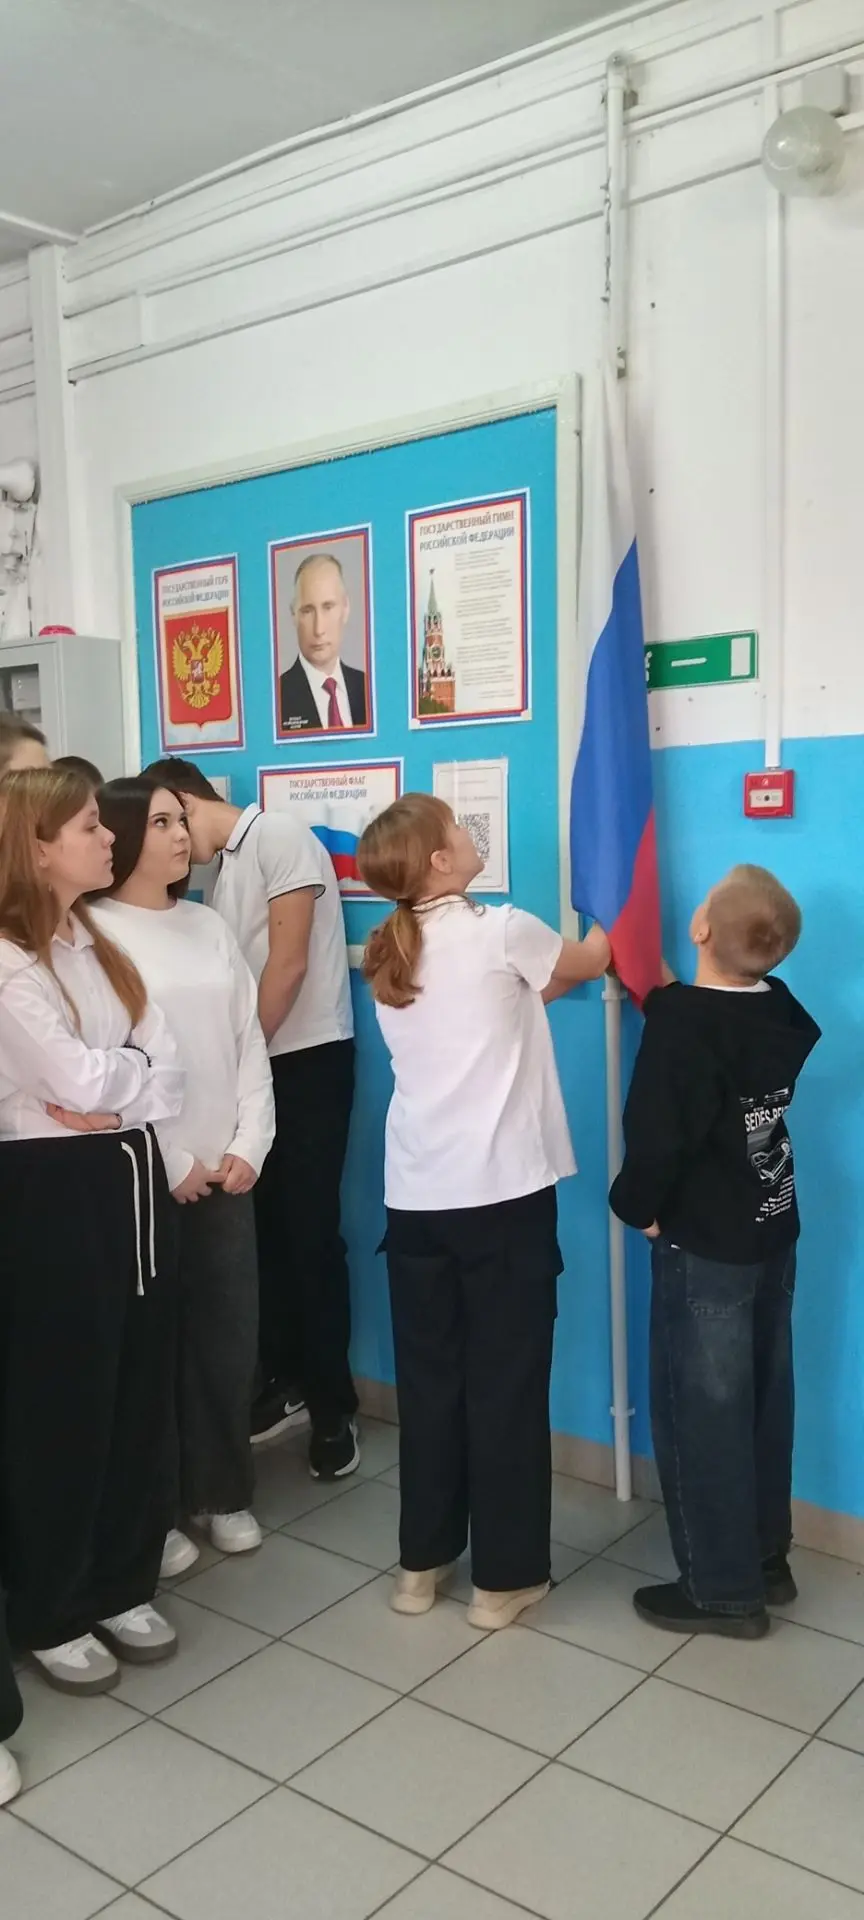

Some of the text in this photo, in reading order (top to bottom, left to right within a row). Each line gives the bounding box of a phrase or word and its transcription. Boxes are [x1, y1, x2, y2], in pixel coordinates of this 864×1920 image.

[419, 510, 515, 536] ГОСУДАРСТВЕННЫЙ ГИМН
[419, 526, 515, 552] РОССИЙСКОЙ ФЕДЕРАЦИИ
[289, 774, 366, 789] ГОСУДАРСТВЕННЫЙ ФЛАГ
[289, 788, 367, 801] РОССИЙСКОЙ ФЕДЕРАЦИИ
